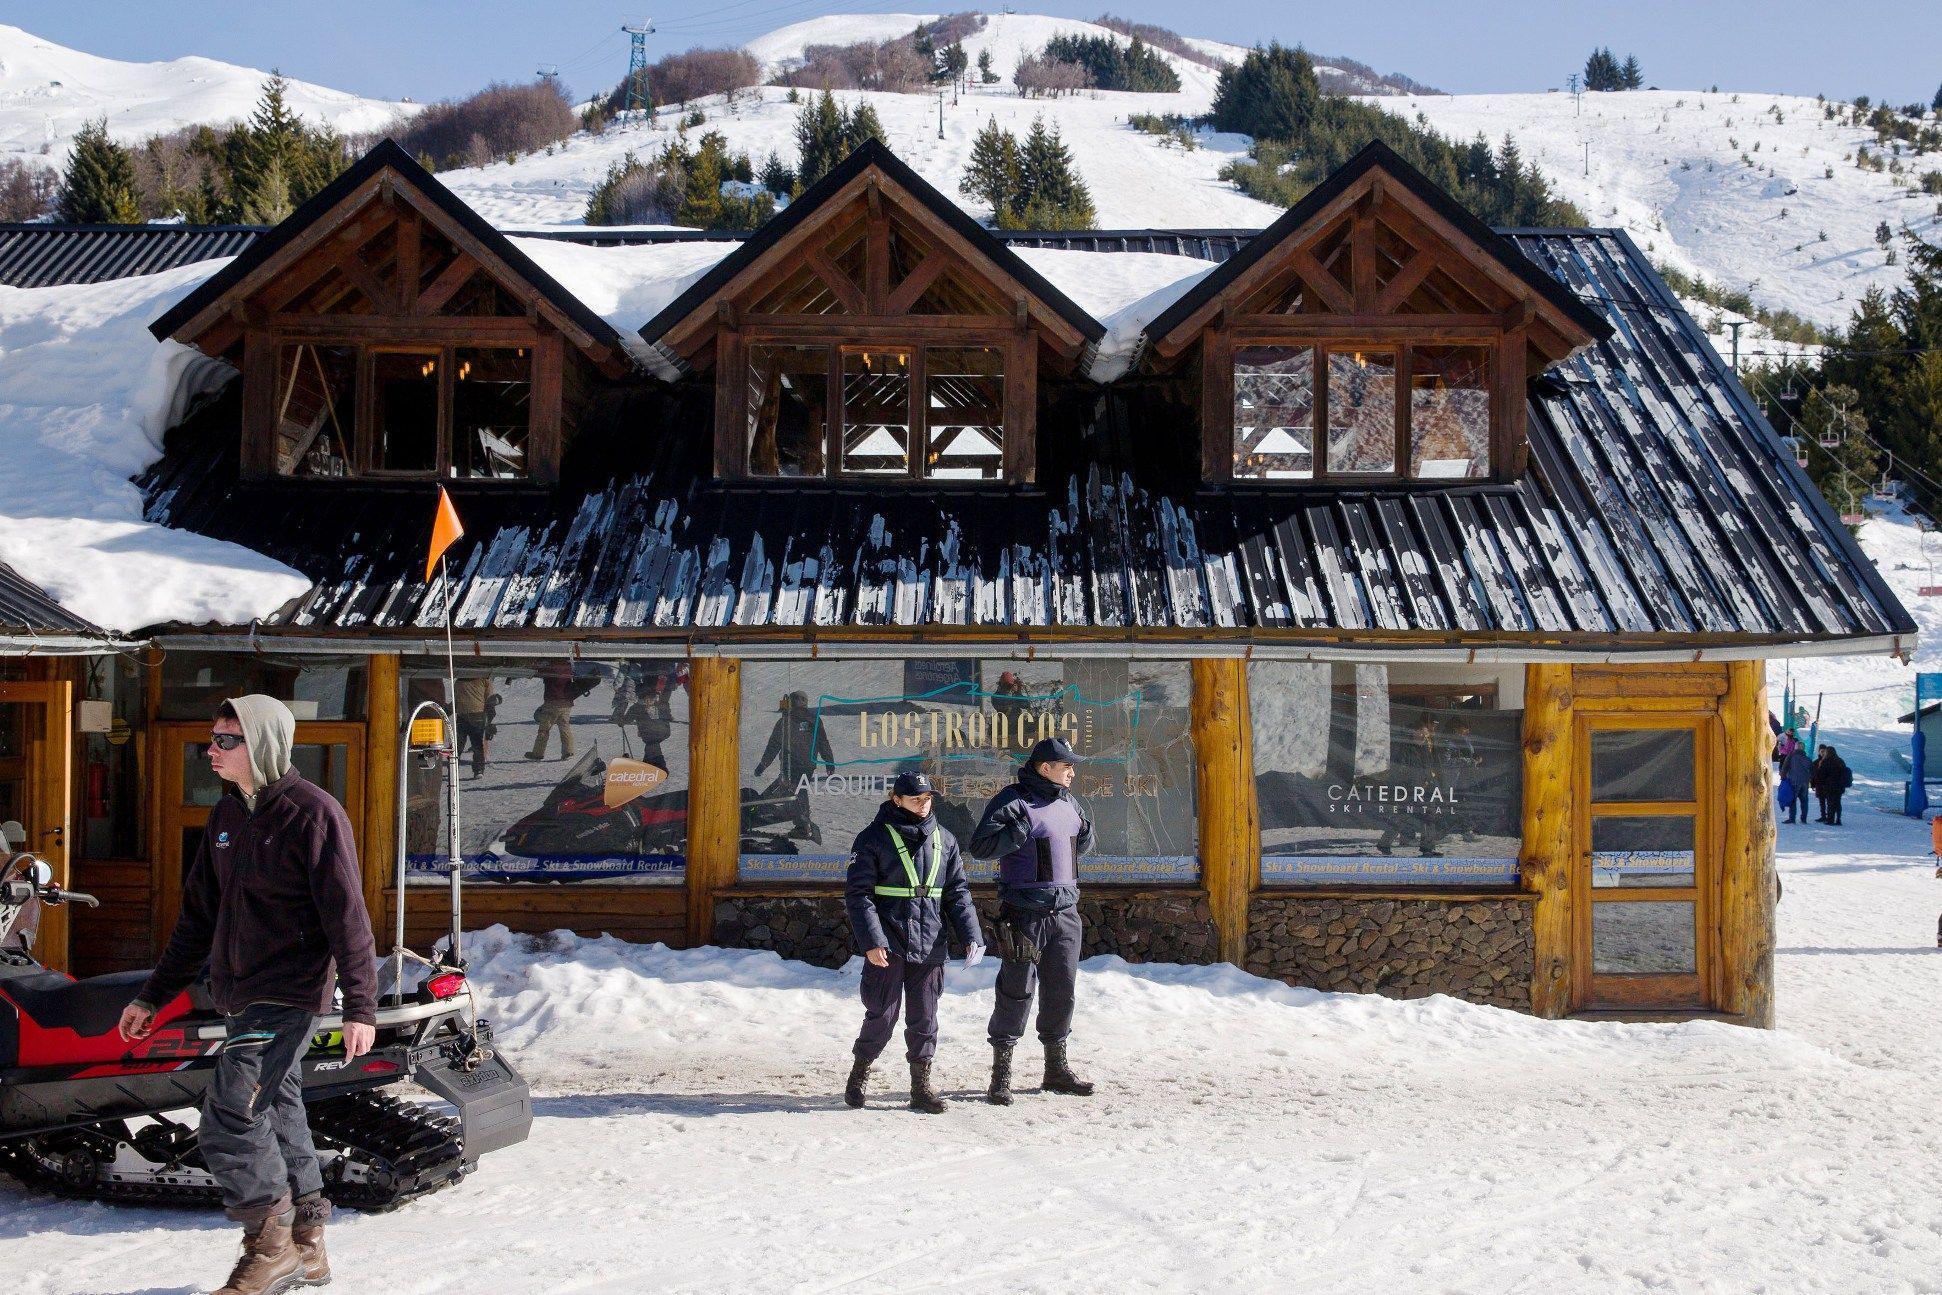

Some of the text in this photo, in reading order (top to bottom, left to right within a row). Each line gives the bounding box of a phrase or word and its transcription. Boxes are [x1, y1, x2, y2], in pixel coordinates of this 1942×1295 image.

[608, 770, 659, 782] catedral
[795, 773, 897, 796] ALQUILE
[1080, 773, 1158, 797] DE SKI
[1327, 784, 1459, 803] CATEDRAL
[1329, 804, 1456, 815] SKI RENTAL
[497, 860, 530, 872] Rental
[542, 859, 673, 871] Ski & Snowboard Rental
[747, 859, 763, 870] Ski
[778, 859, 840, 870] Snowboard
[1267, 861, 1282, 873] Ski
[1298, 861, 1358, 873] Snowboard
[1362, 862, 1398, 873] Rental
[1412, 862, 1428, 874] Ski
[1444, 863, 1505, 875] Snowboard
